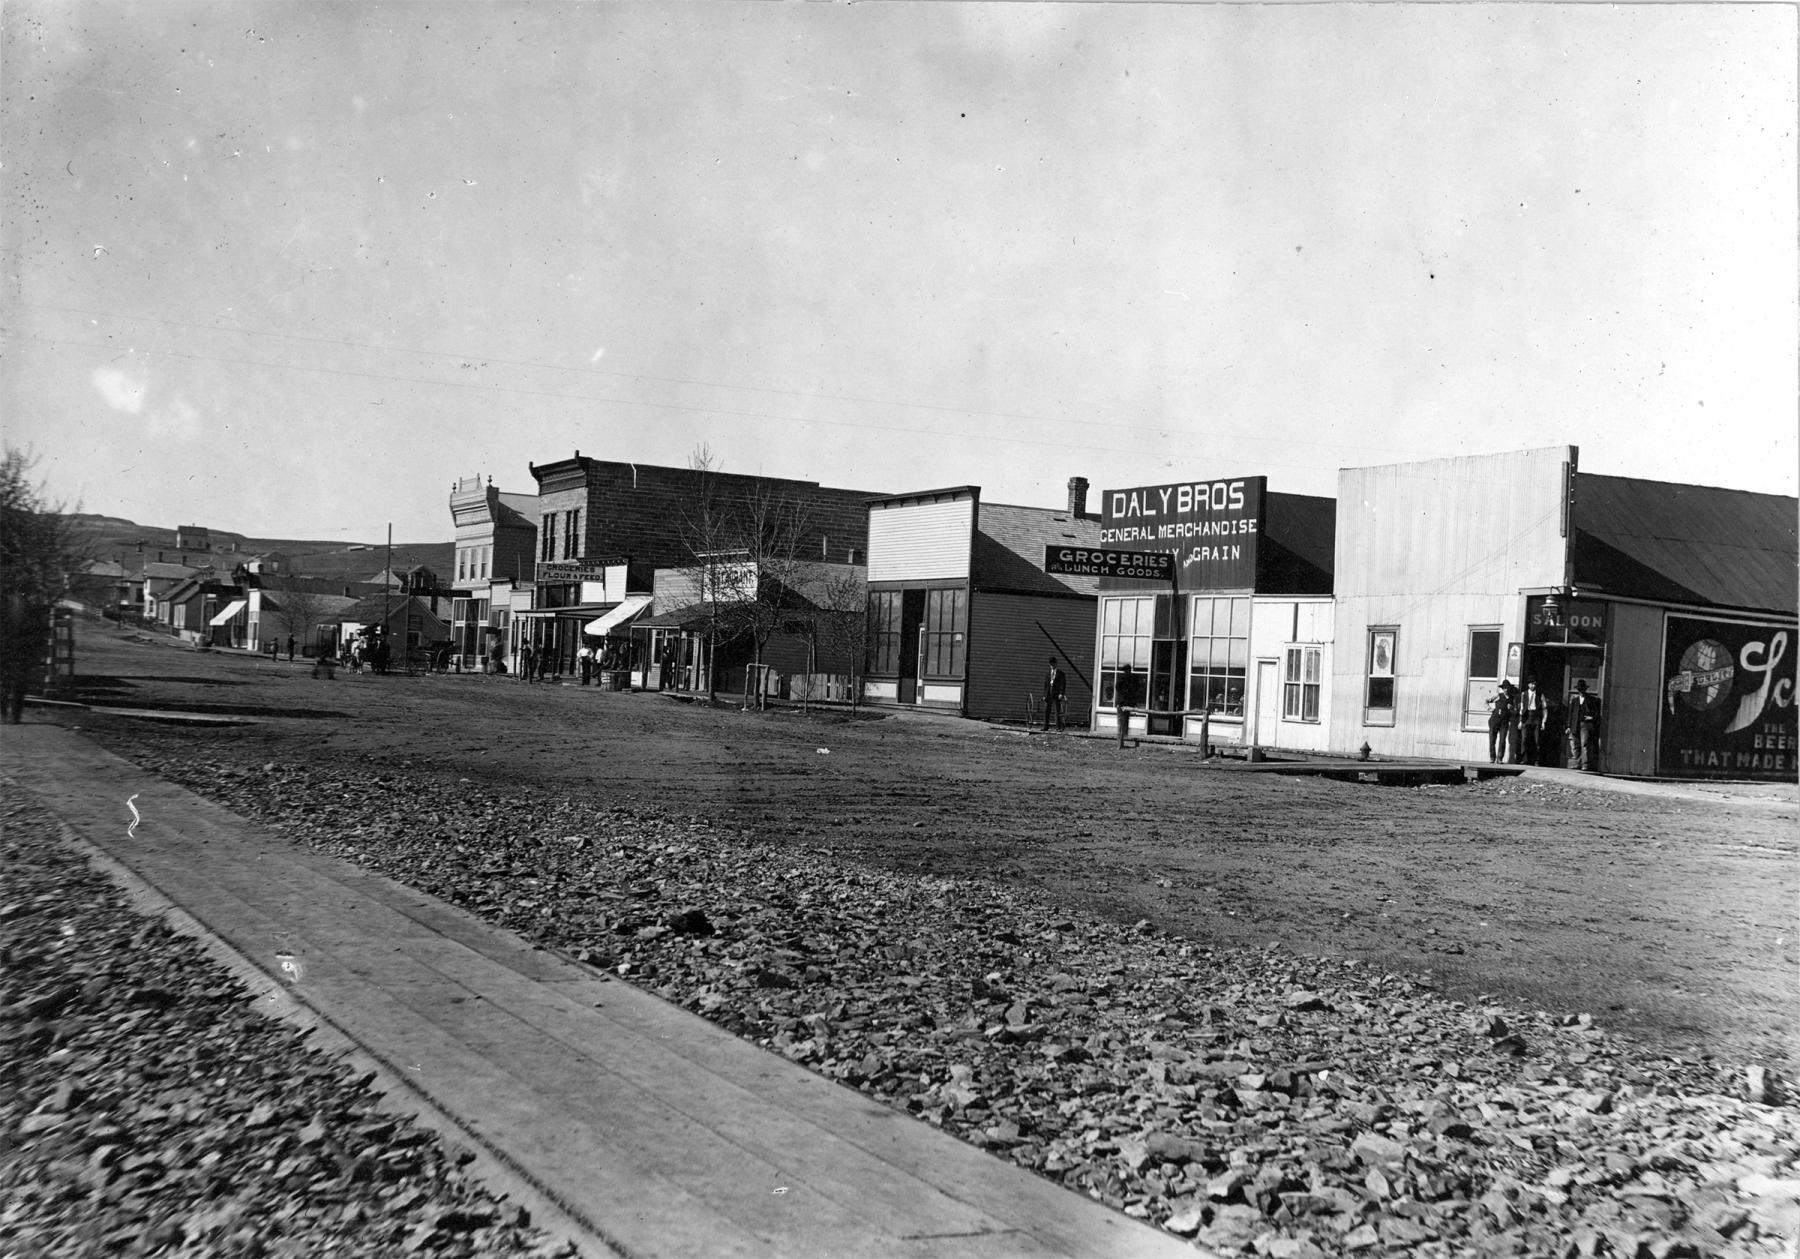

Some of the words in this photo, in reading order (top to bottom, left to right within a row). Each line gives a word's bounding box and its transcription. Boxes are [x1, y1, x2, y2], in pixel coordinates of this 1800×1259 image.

[1112, 488, 1172, 518] DALY
[1177, 481, 1245, 513] BROS
[1100, 526, 1156, 542] GENERAL
[1158, 519, 1258, 539] MERCHANDISE
[1059, 550, 1168, 567] GROCERIES
[1193, 545, 1240, 561] GRAIN
[543, 572, 571, 580] FLOUR
[546, 564, 595, 573] GROCERIES
[1065, 563, 1109, 574] LUNCH
[1532, 614, 1603, 628] SALOON
[1724, 631, 1799, 733] Sc
[1754, 734, 1798, 750] BEER
[1681, 749, 1732, 767] THAT
[1737, 752, 1786, 770] MADE
